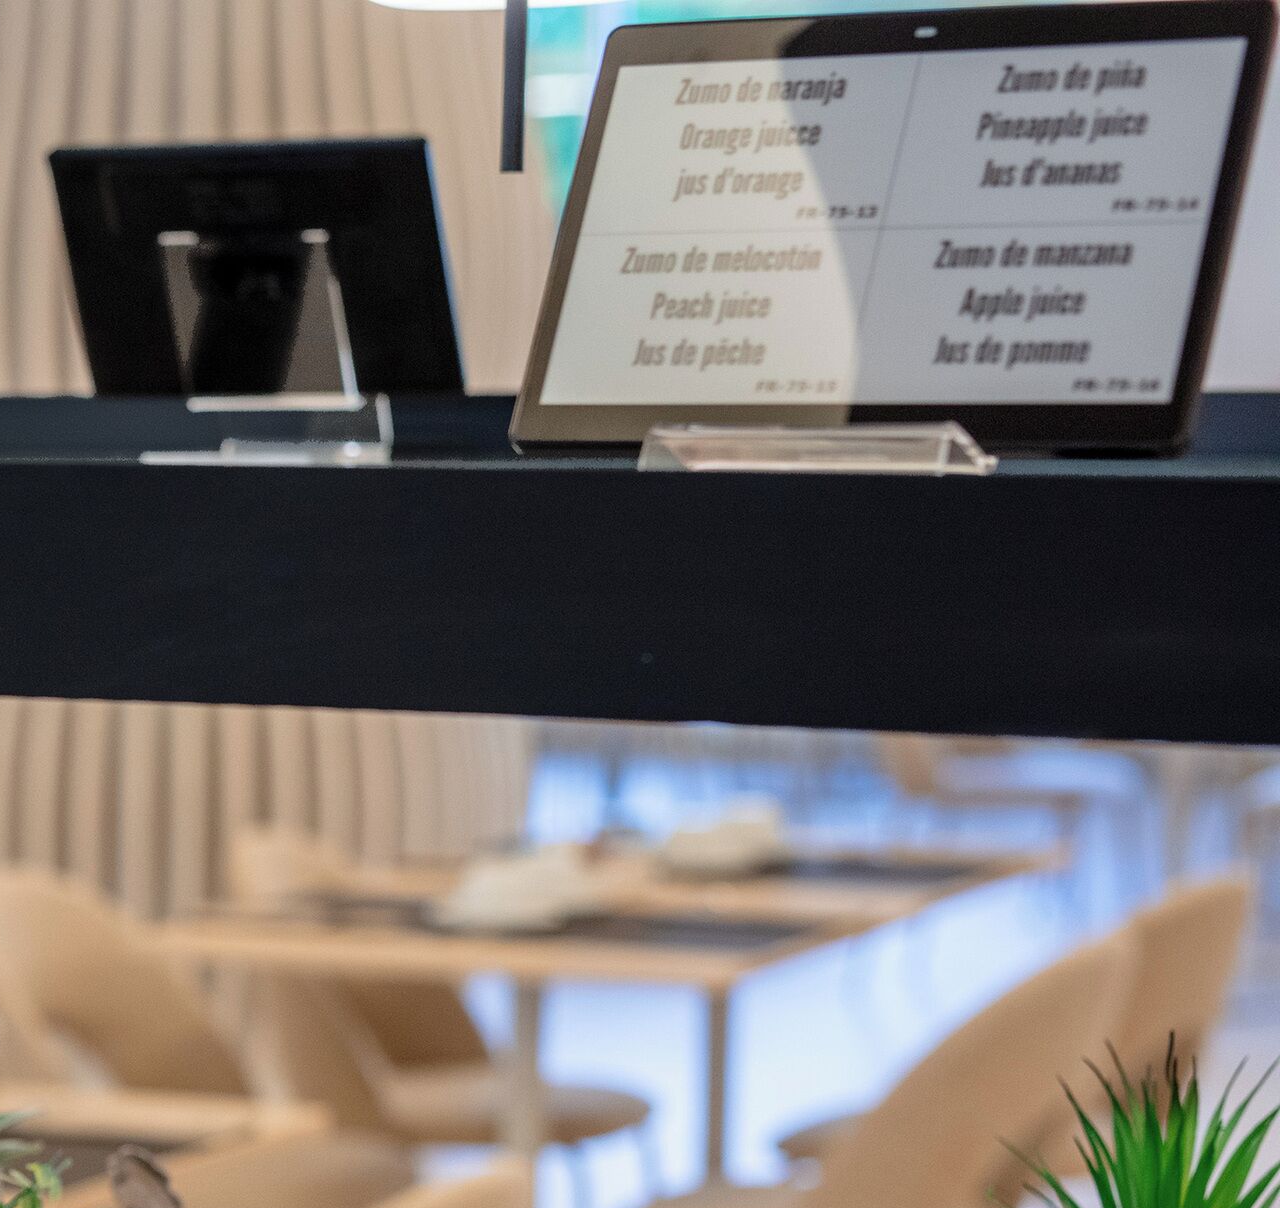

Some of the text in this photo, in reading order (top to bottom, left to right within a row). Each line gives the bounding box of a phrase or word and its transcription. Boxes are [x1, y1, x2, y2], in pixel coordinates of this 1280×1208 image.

[674, 71, 847, 106] Zumo de naranja
[997, 64, 1059, 93] Zumo
[1063, 62, 1091, 91] de
[679, 122, 753, 156] Orange
[976, 107, 1149, 145] Pineapple juice
[673, 167, 804, 203] jus d'orange
[979, 158, 1016, 188] Jus
[620, 246, 677, 275] Zumo
[681, 245, 708, 273] de
[933, 238, 1134, 269] Zumo de manzana
[650, 289, 772, 326] Peach juice
[958, 284, 1086, 323] Apple juice
[631, 337, 667, 367] Jus
[670, 337, 697, 366] de
[933, 334, 1092, 371] Jus de pomme
